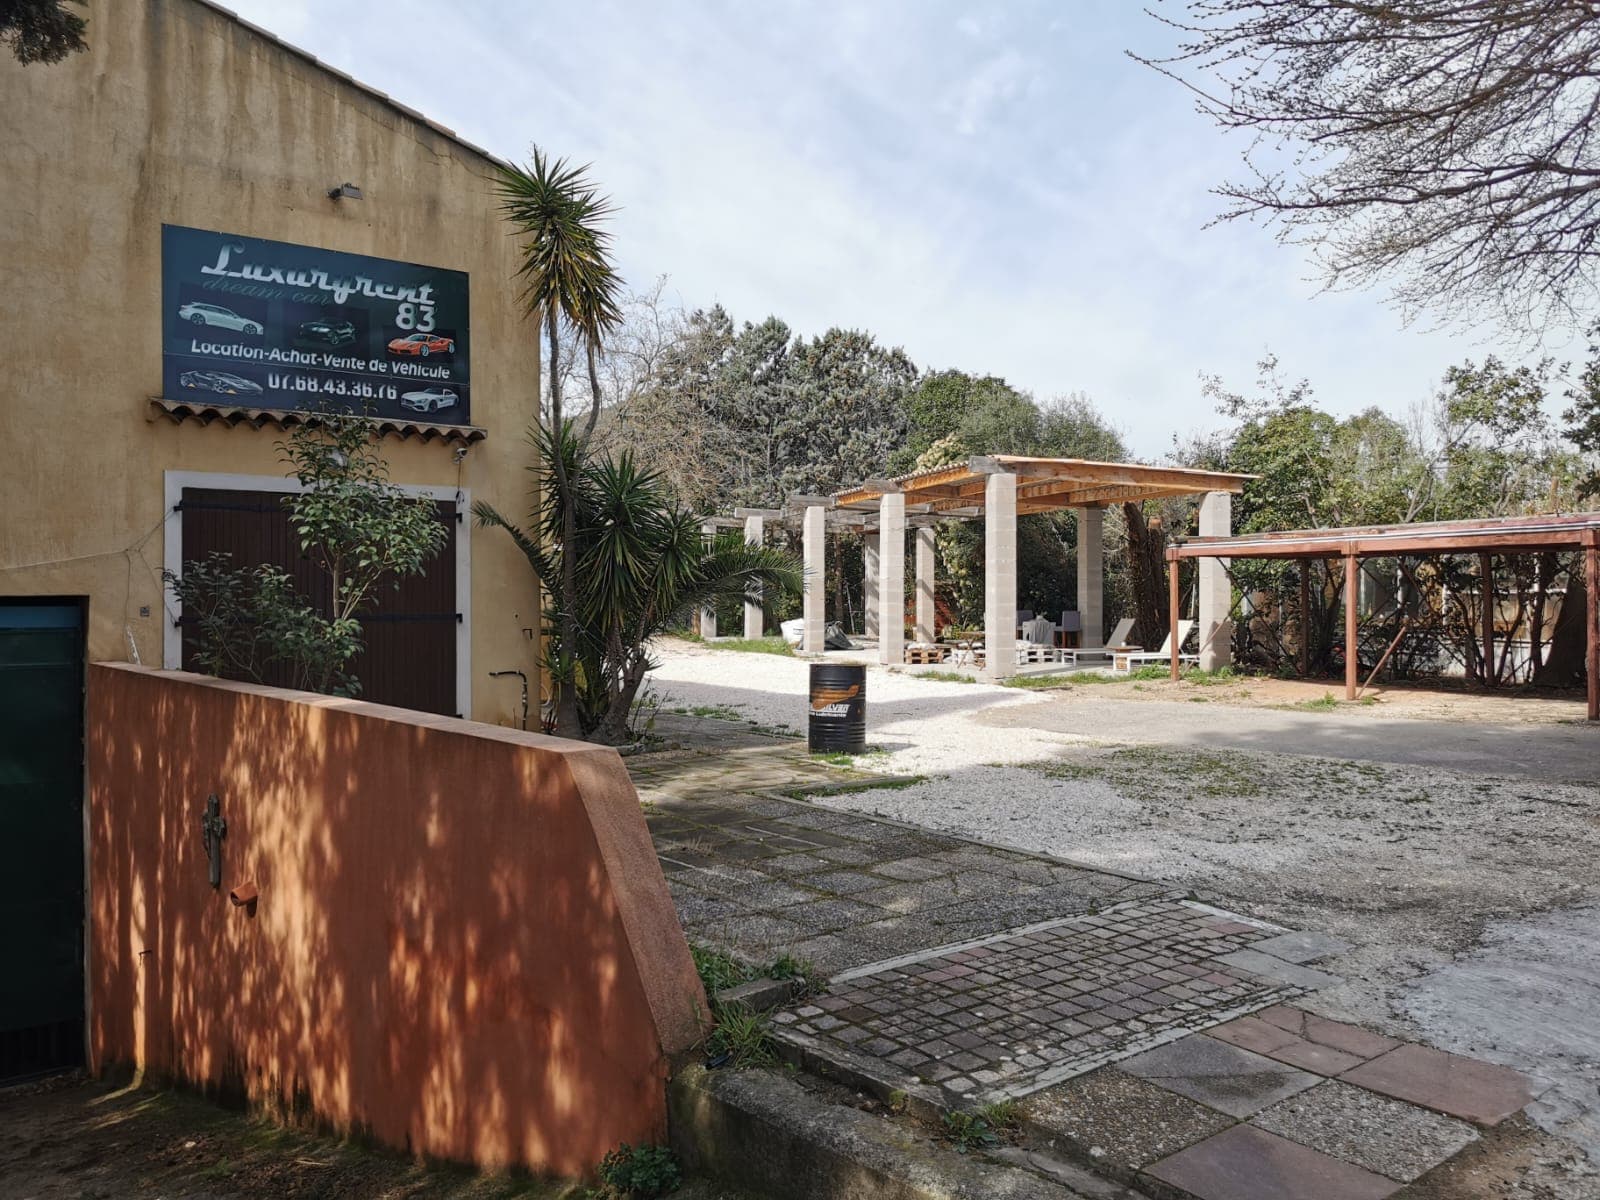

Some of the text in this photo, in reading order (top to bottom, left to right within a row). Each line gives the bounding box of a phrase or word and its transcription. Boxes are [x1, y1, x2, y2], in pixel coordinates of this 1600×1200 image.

[202, 277, 333, 306] dream car
[395, 303, 437, 332] 83
[369, 359, 387, 373] de
[267, 373, 397, 400] 07.68.43.36.76
